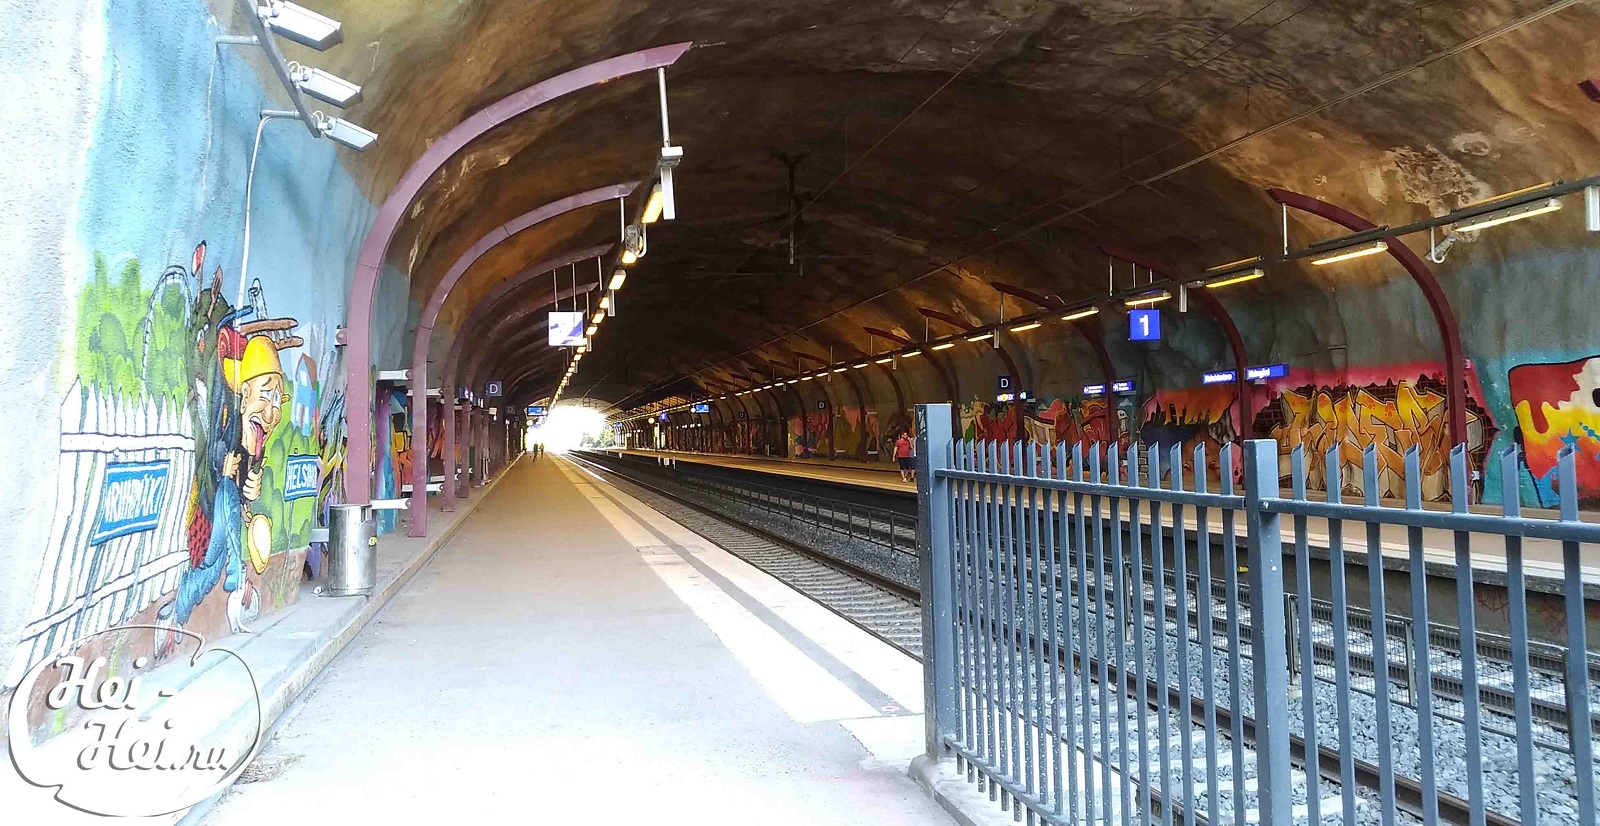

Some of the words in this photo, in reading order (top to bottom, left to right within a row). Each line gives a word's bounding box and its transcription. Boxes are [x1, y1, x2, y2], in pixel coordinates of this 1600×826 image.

[1139, 314, 1149, 336] 1
[489, 383, 498, 394] D
[1000, 378, 1009, 388] D
